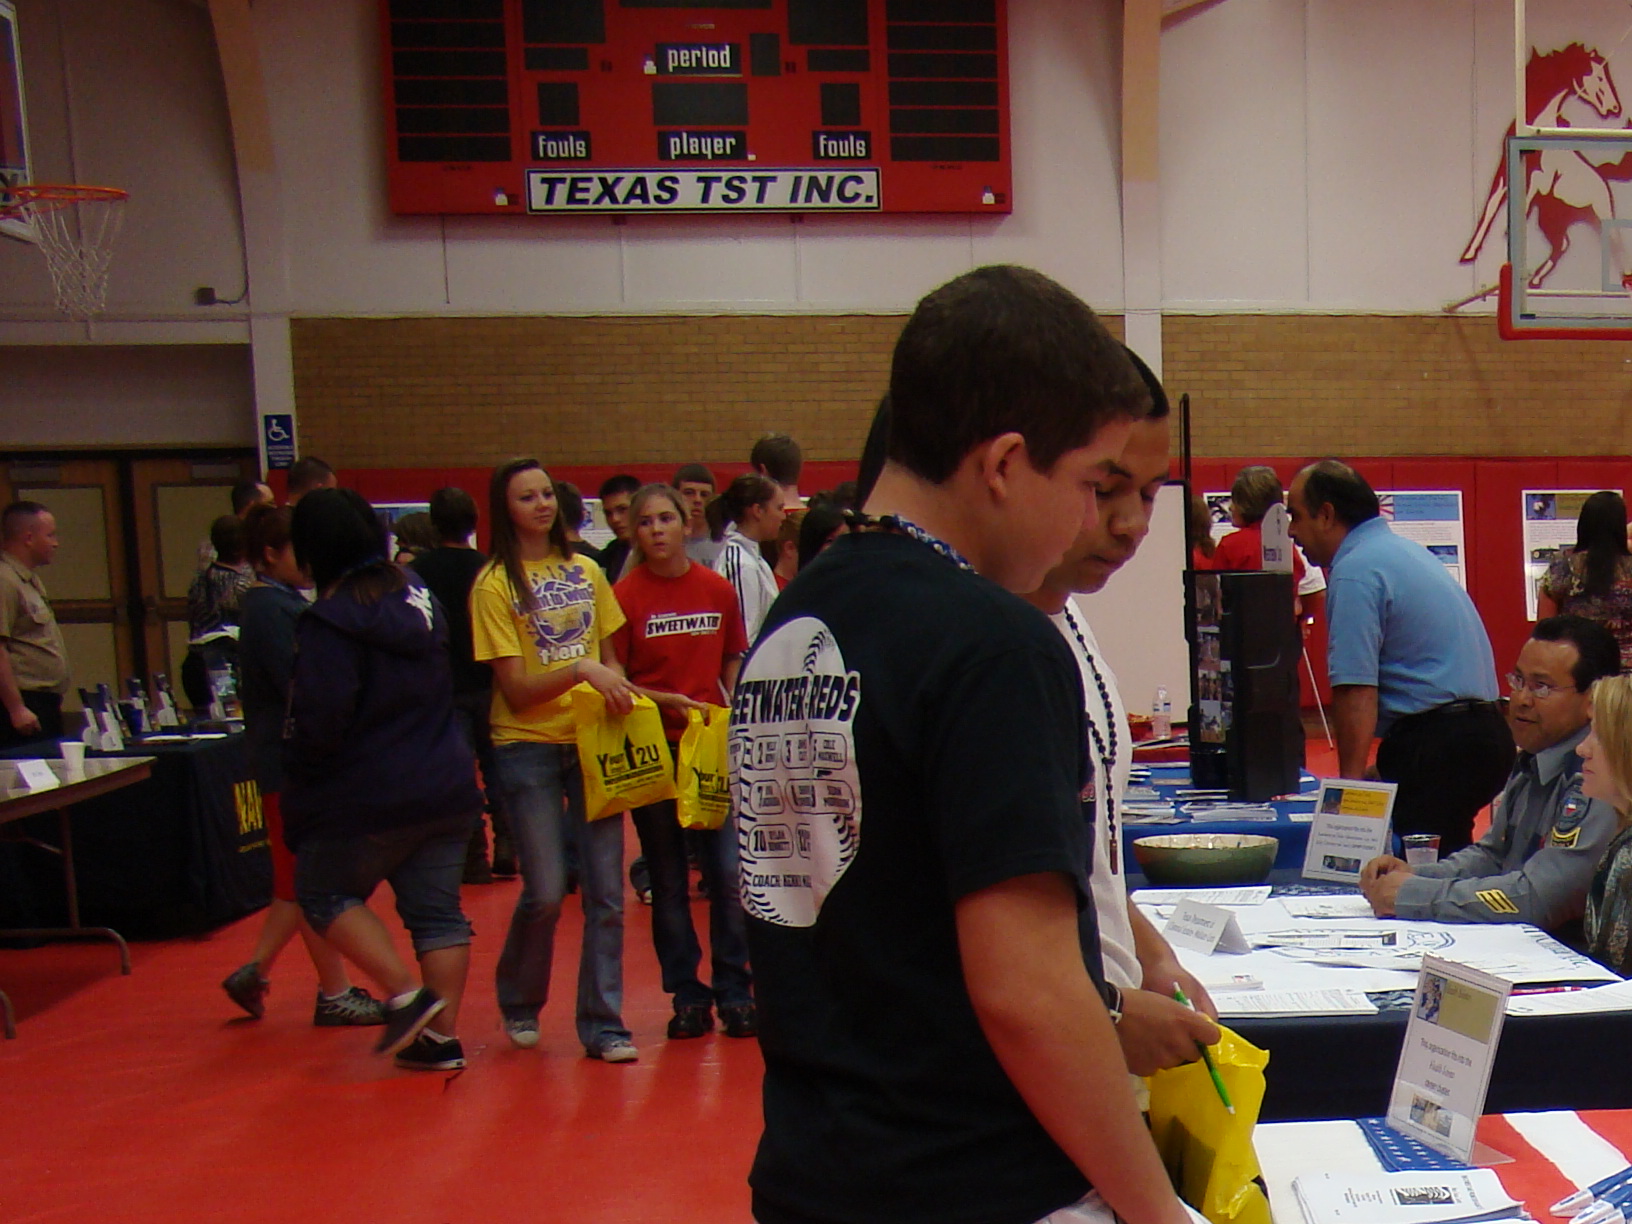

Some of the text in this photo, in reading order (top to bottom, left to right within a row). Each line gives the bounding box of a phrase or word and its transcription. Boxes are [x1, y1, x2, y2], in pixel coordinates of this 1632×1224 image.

[667, 45, 731, 72] period
[538, 135, 586, 157] fouls
[669, 132, 736, 159] player
[819, 135, 866, 157] fouls
[539, 174, 875, 206] TEXAS TST INC.
[808, 675, 859, 721] REDS
[636, 743, 660, 765] 2U
[233, 779, 263, 835] NAV
